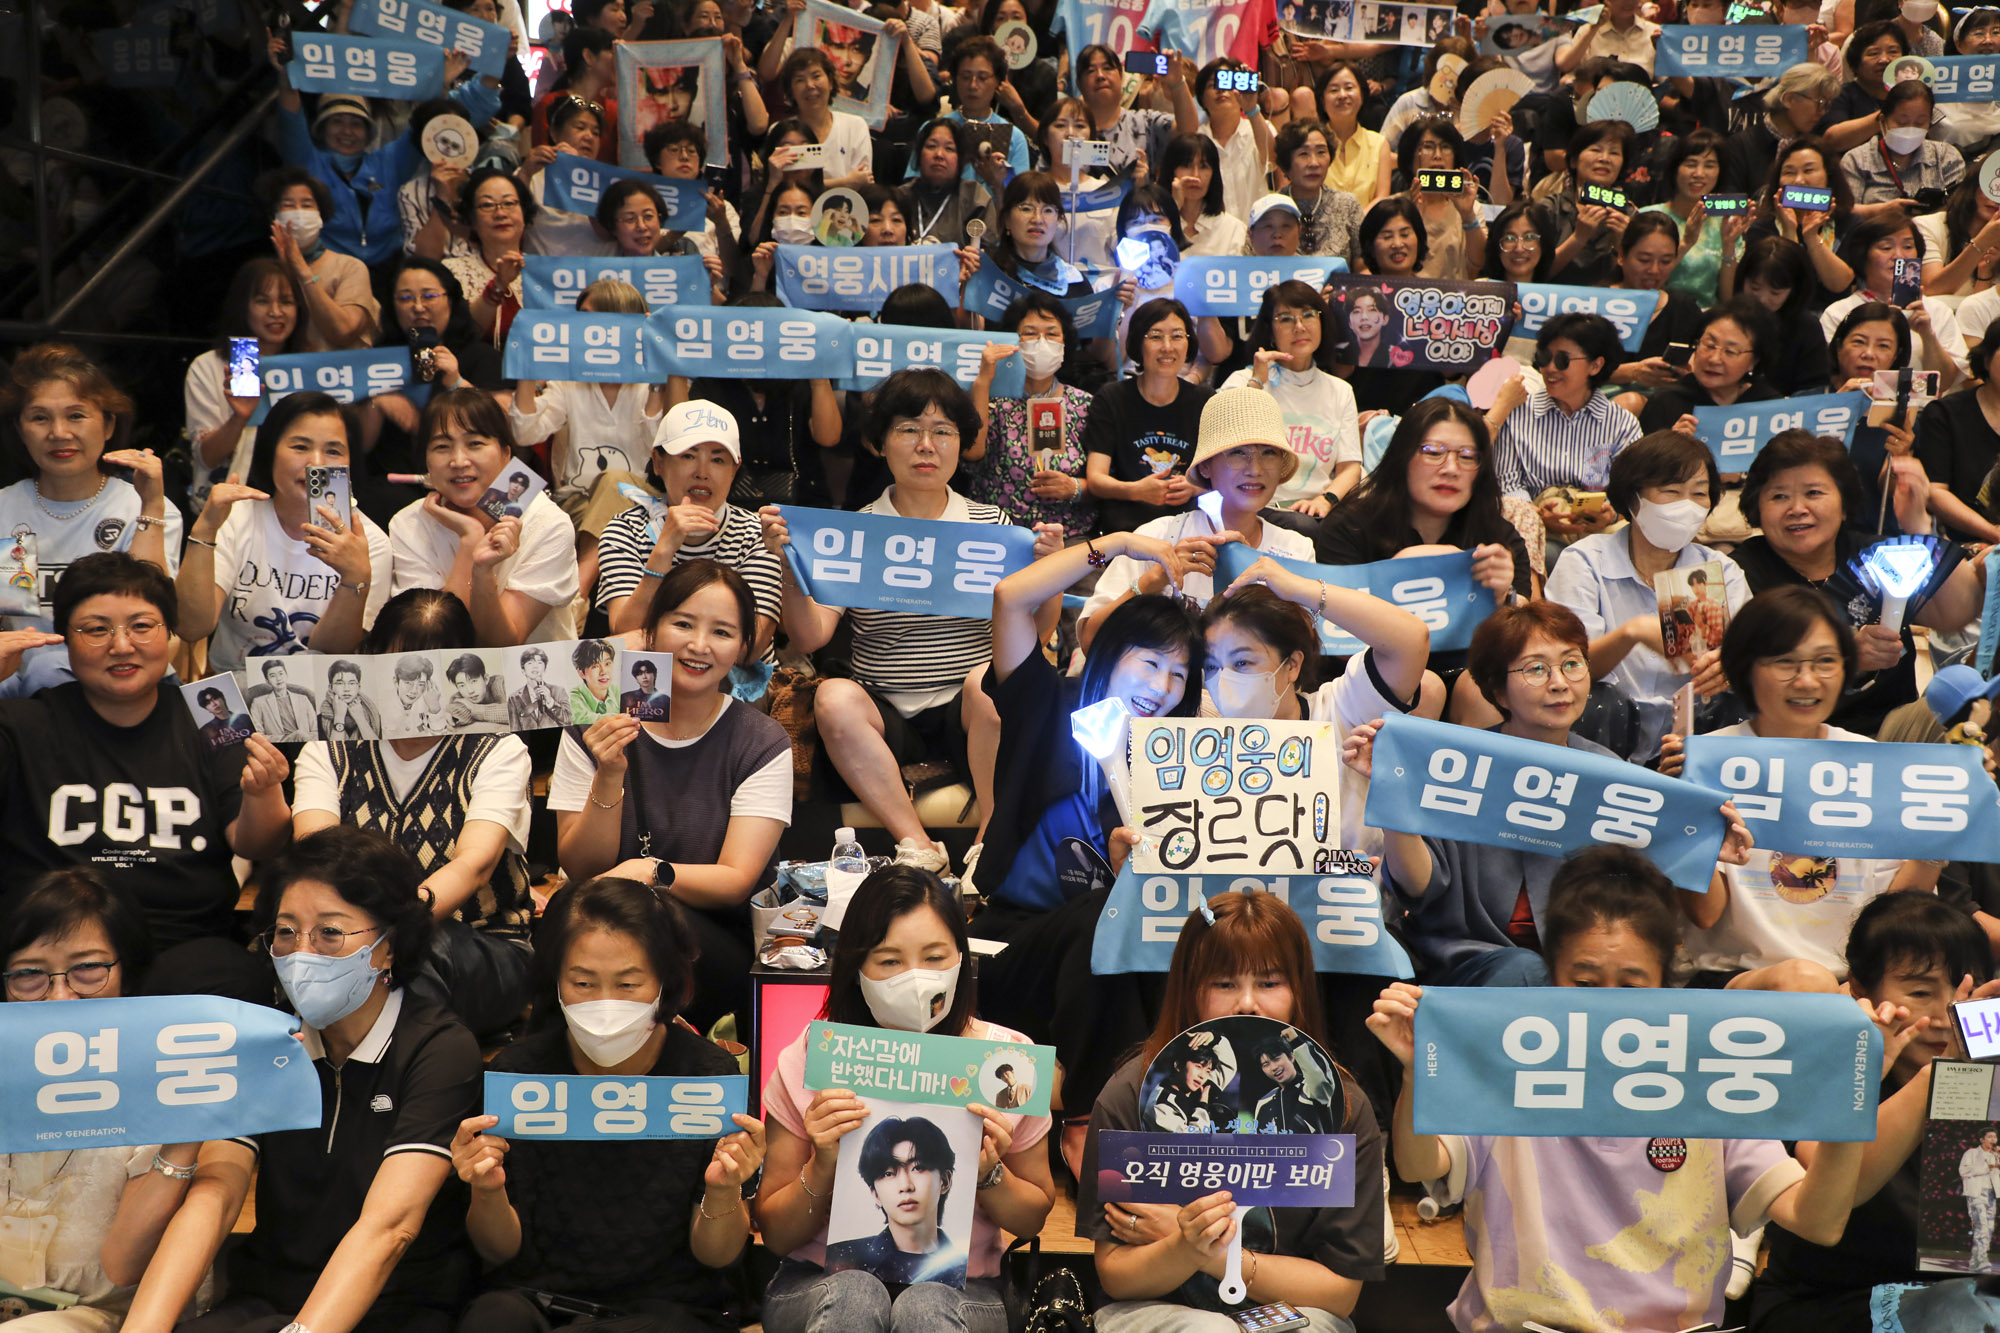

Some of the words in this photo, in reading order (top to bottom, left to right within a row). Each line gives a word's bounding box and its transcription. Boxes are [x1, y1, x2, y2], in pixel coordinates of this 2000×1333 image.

[302, 43, 417, 87] 임영웅
[1682, 35, 1782, 66] 임영웅
[571, 168, 680, 217] 임웅
[1419, 174, 1461, 188] 임영웅
[1588, 185, 1626, 208] 임영웅
[532, 322, 644, 365] 임영
[675, 317, 817, 363] 임영웅
[1132, 435, 1159, 449] TASTY
[1161, 435, 1190, 450] TREAT
[812, 526, 1007, 594] 임영웅
[1145, 724, 1312, 796] 임영웅이
[1419, 747, 1665, 849] 임영웅
[1719, 756, 1970, 832] 임영웅
[47, 782, 206, 852] CGP.
[1330, 849, 1355, 862] IM
[1498, 831, 1516, 840] HERO
[1518, 834, 1563, 850] GENERATION
[1803, 839, 1824, 848] HERO
[1826, 840, 1874, 850] GENERATION
[1314, 860, 1374, 877] HERO
[831, 1034, 922, 1066] 자신감에
[1426, 1042, 1438, 1077] HERO
[1502, 1012, 1793, 1115] 임영웅
[830, 1061, 947, 1096] 반했다니까!
[1852, 1029, 1869, 1112] GENERATION
[511, 1081, 726, 1135] 임영웅
[36, 1131, 63, 1141] HERO
[65, 1127, 126, 1139] GENERATION
[1151, 1146, 1176, 1155] ALL
[1210, 1147, 1235, 1156] SEE
[1279, 1148, 1304, 1157] YOU
[1120, 1161, 1170, 1188] 오직
[1179, 1161, 1276, 1190] 영웅이만
[1285, 1163, 1334, 1190] 보여
